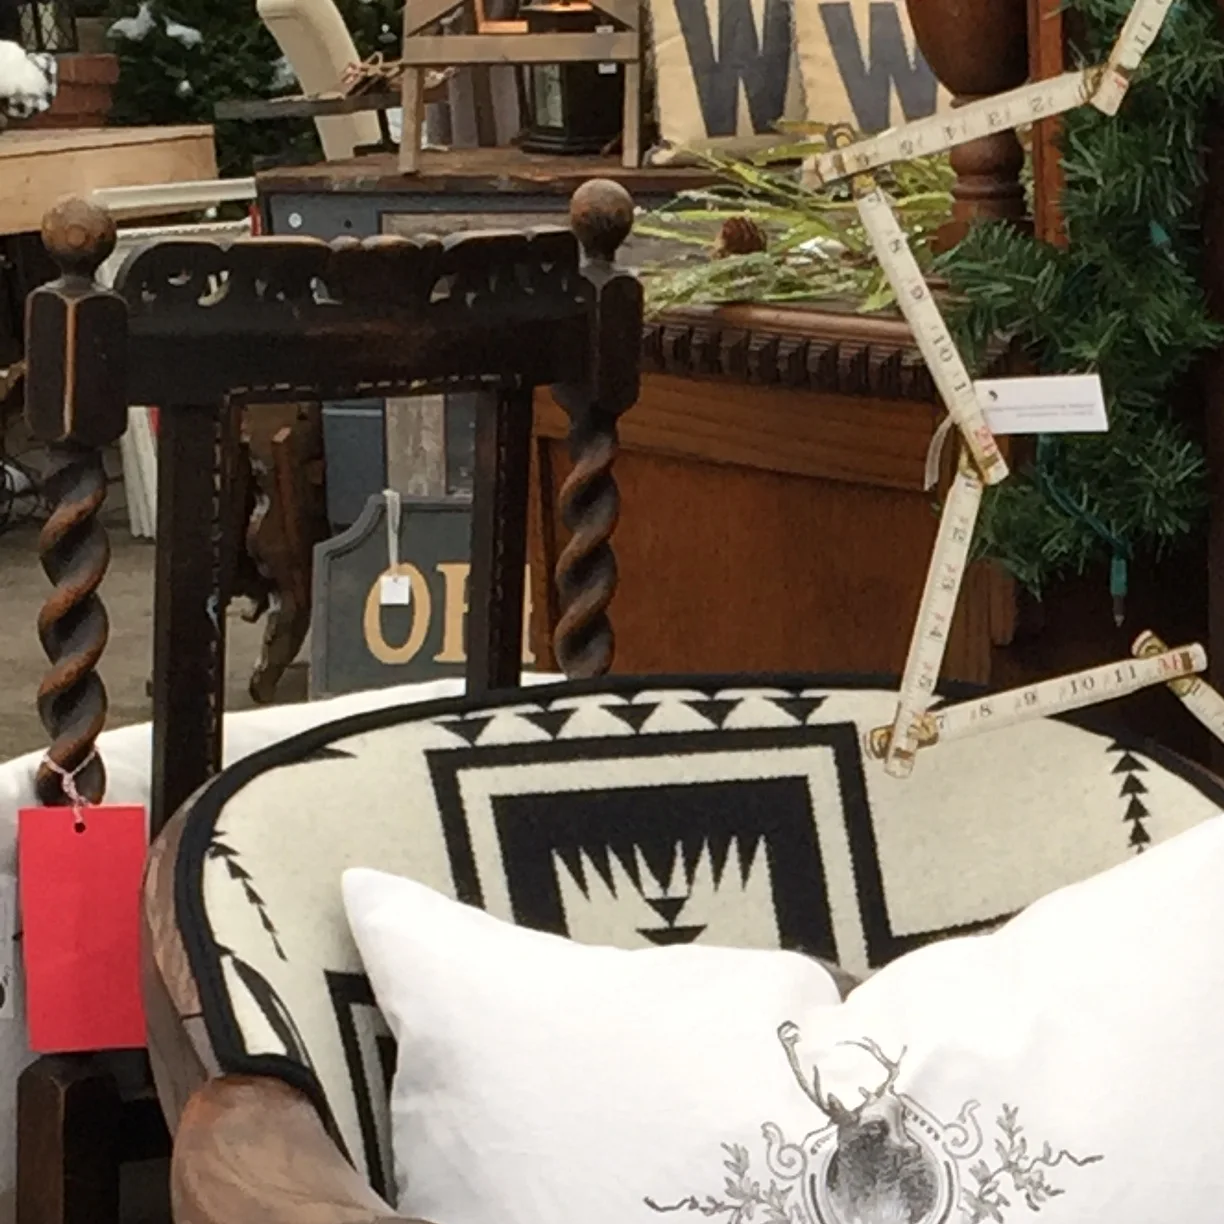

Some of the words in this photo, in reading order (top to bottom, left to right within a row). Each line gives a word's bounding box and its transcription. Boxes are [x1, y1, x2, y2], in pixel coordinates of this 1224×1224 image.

[818, 2, 938, 134] W
[978, 703, 992, 717] 8
[1069, 674, 1094, 693] 10
[1113, 664, 1136, 682] 11
